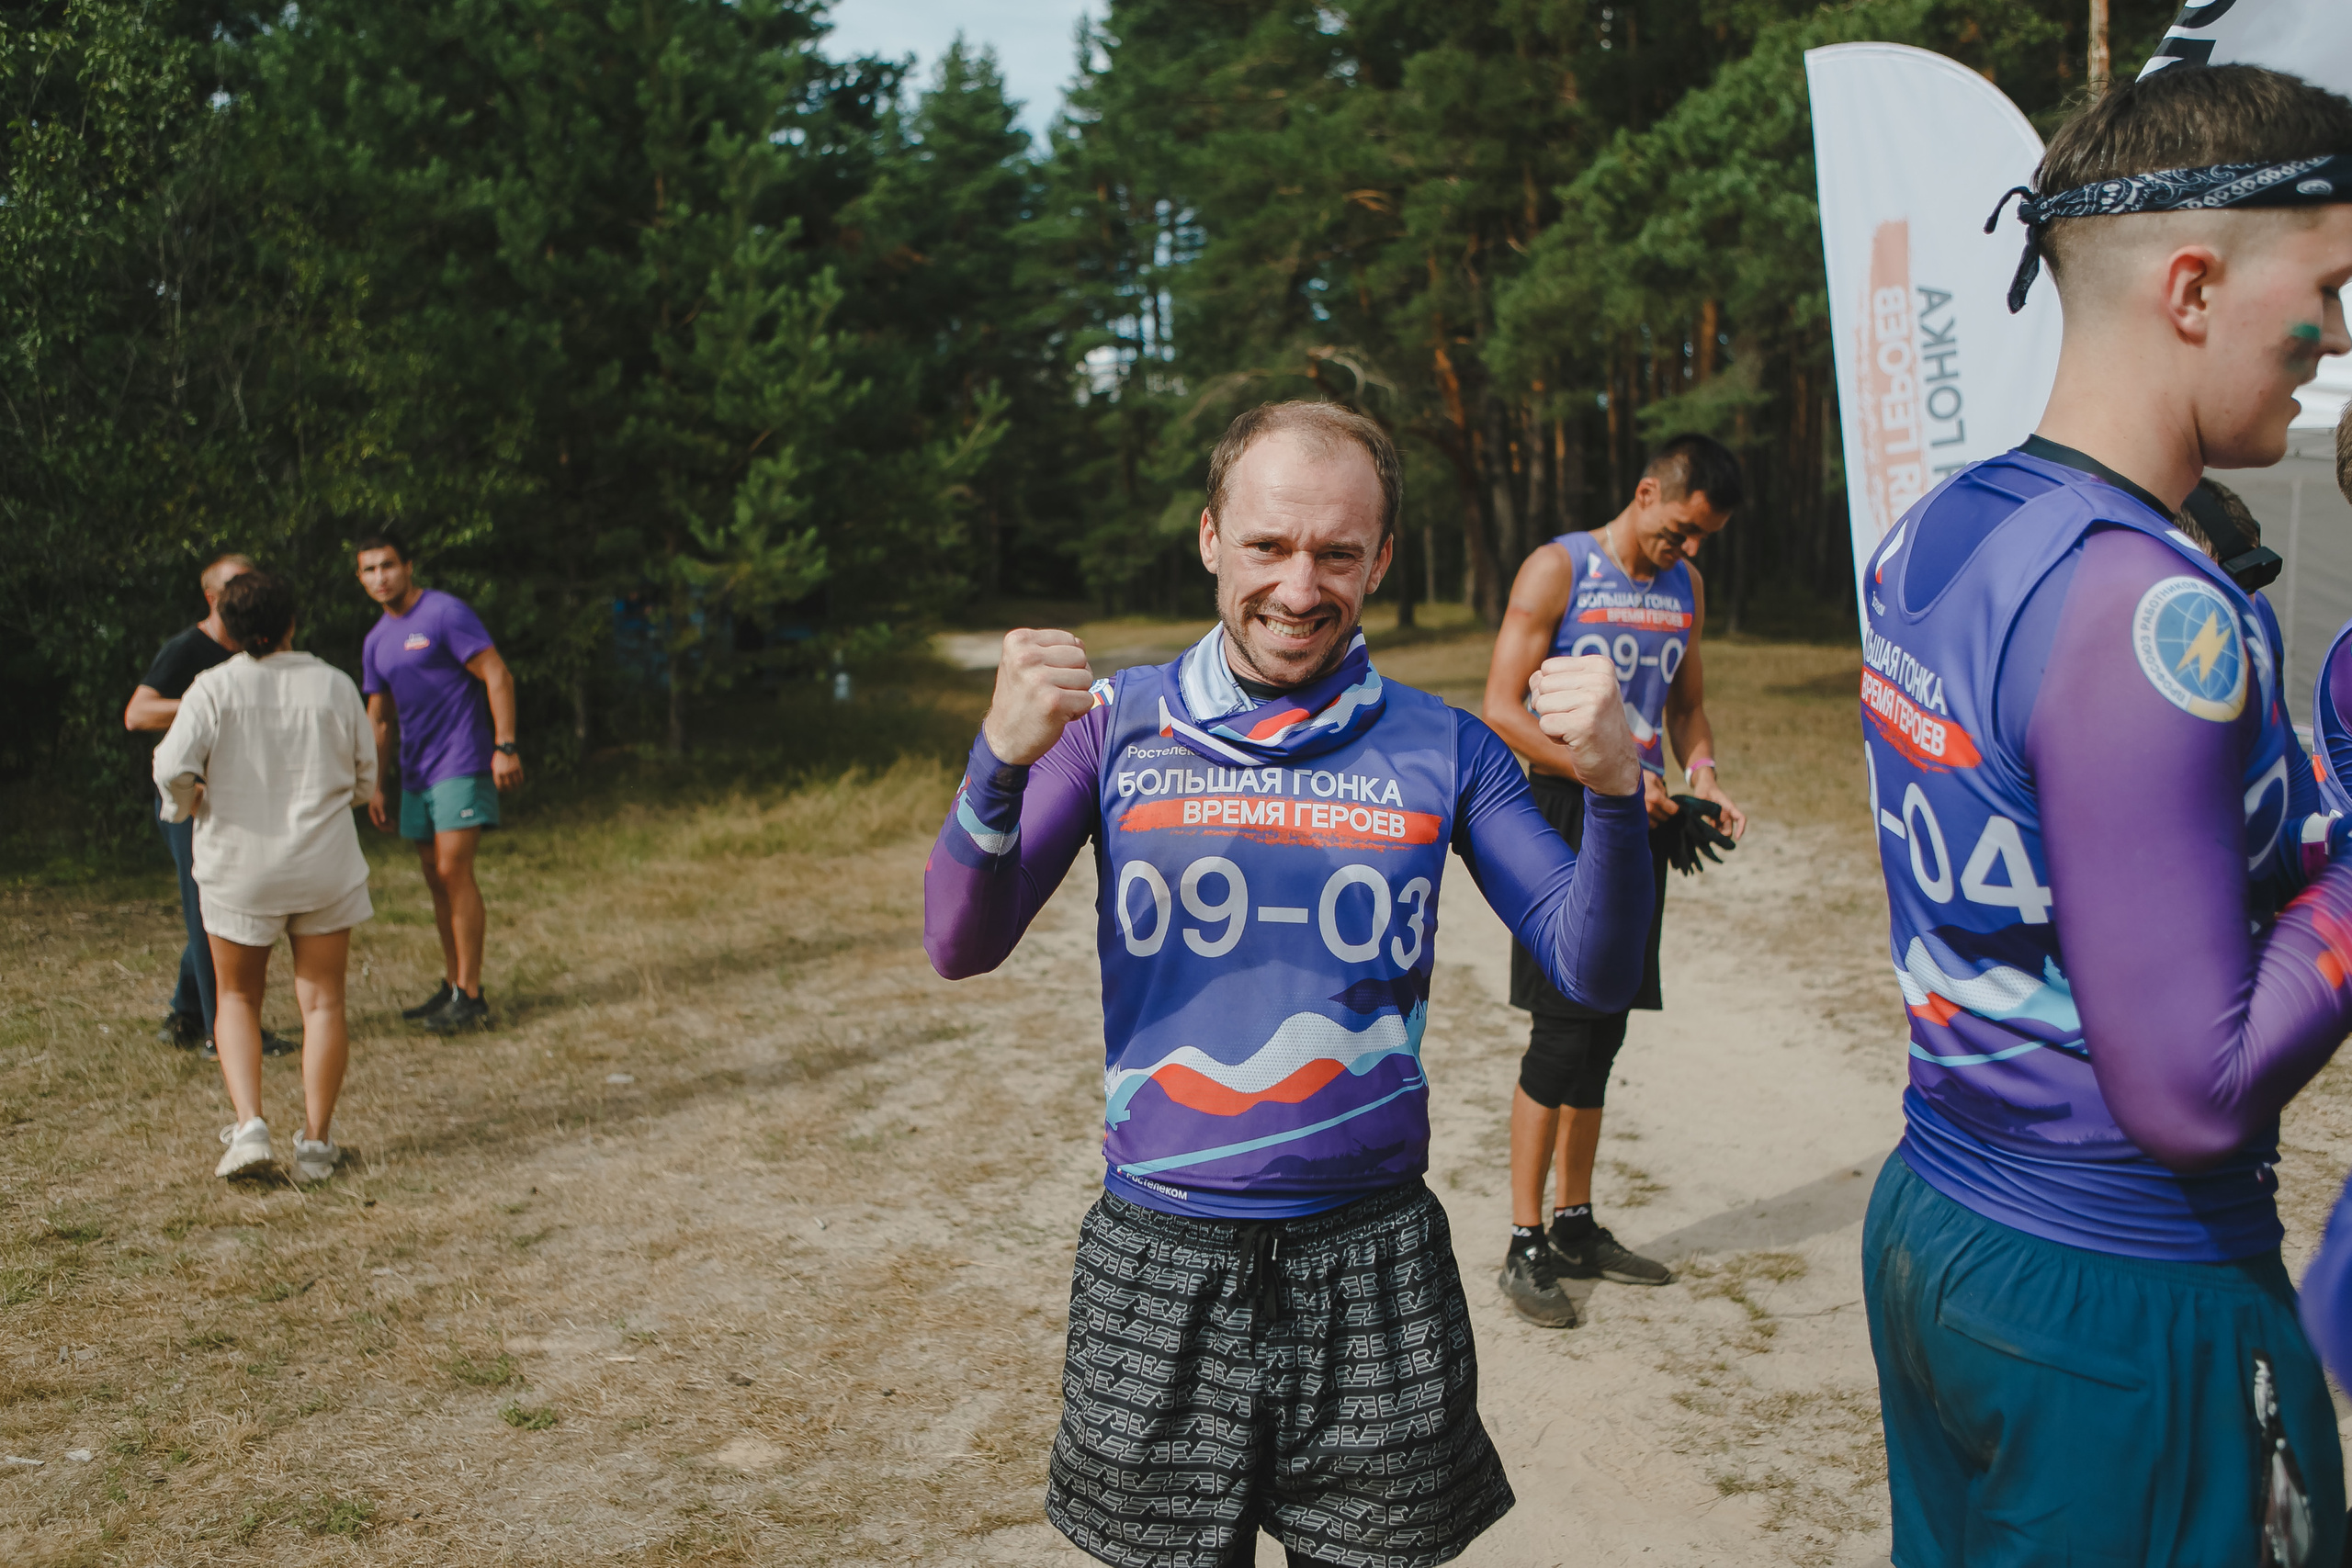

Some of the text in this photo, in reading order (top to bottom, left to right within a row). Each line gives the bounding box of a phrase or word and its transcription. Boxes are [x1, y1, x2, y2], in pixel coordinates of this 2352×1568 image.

[1860, 671, 1946, 757] ВРЕМЯ ГЕРОЕВ
[1897, 651, 1948, 716] ГОНКА
[1117, 766, 1405, 808] БОЛЬШАЯ ГОНКА
[1182, 799, 1407, 839] ВРЕМЯ ГЕРОЕВ
[1117, 855, 1432, 971] 09-03
